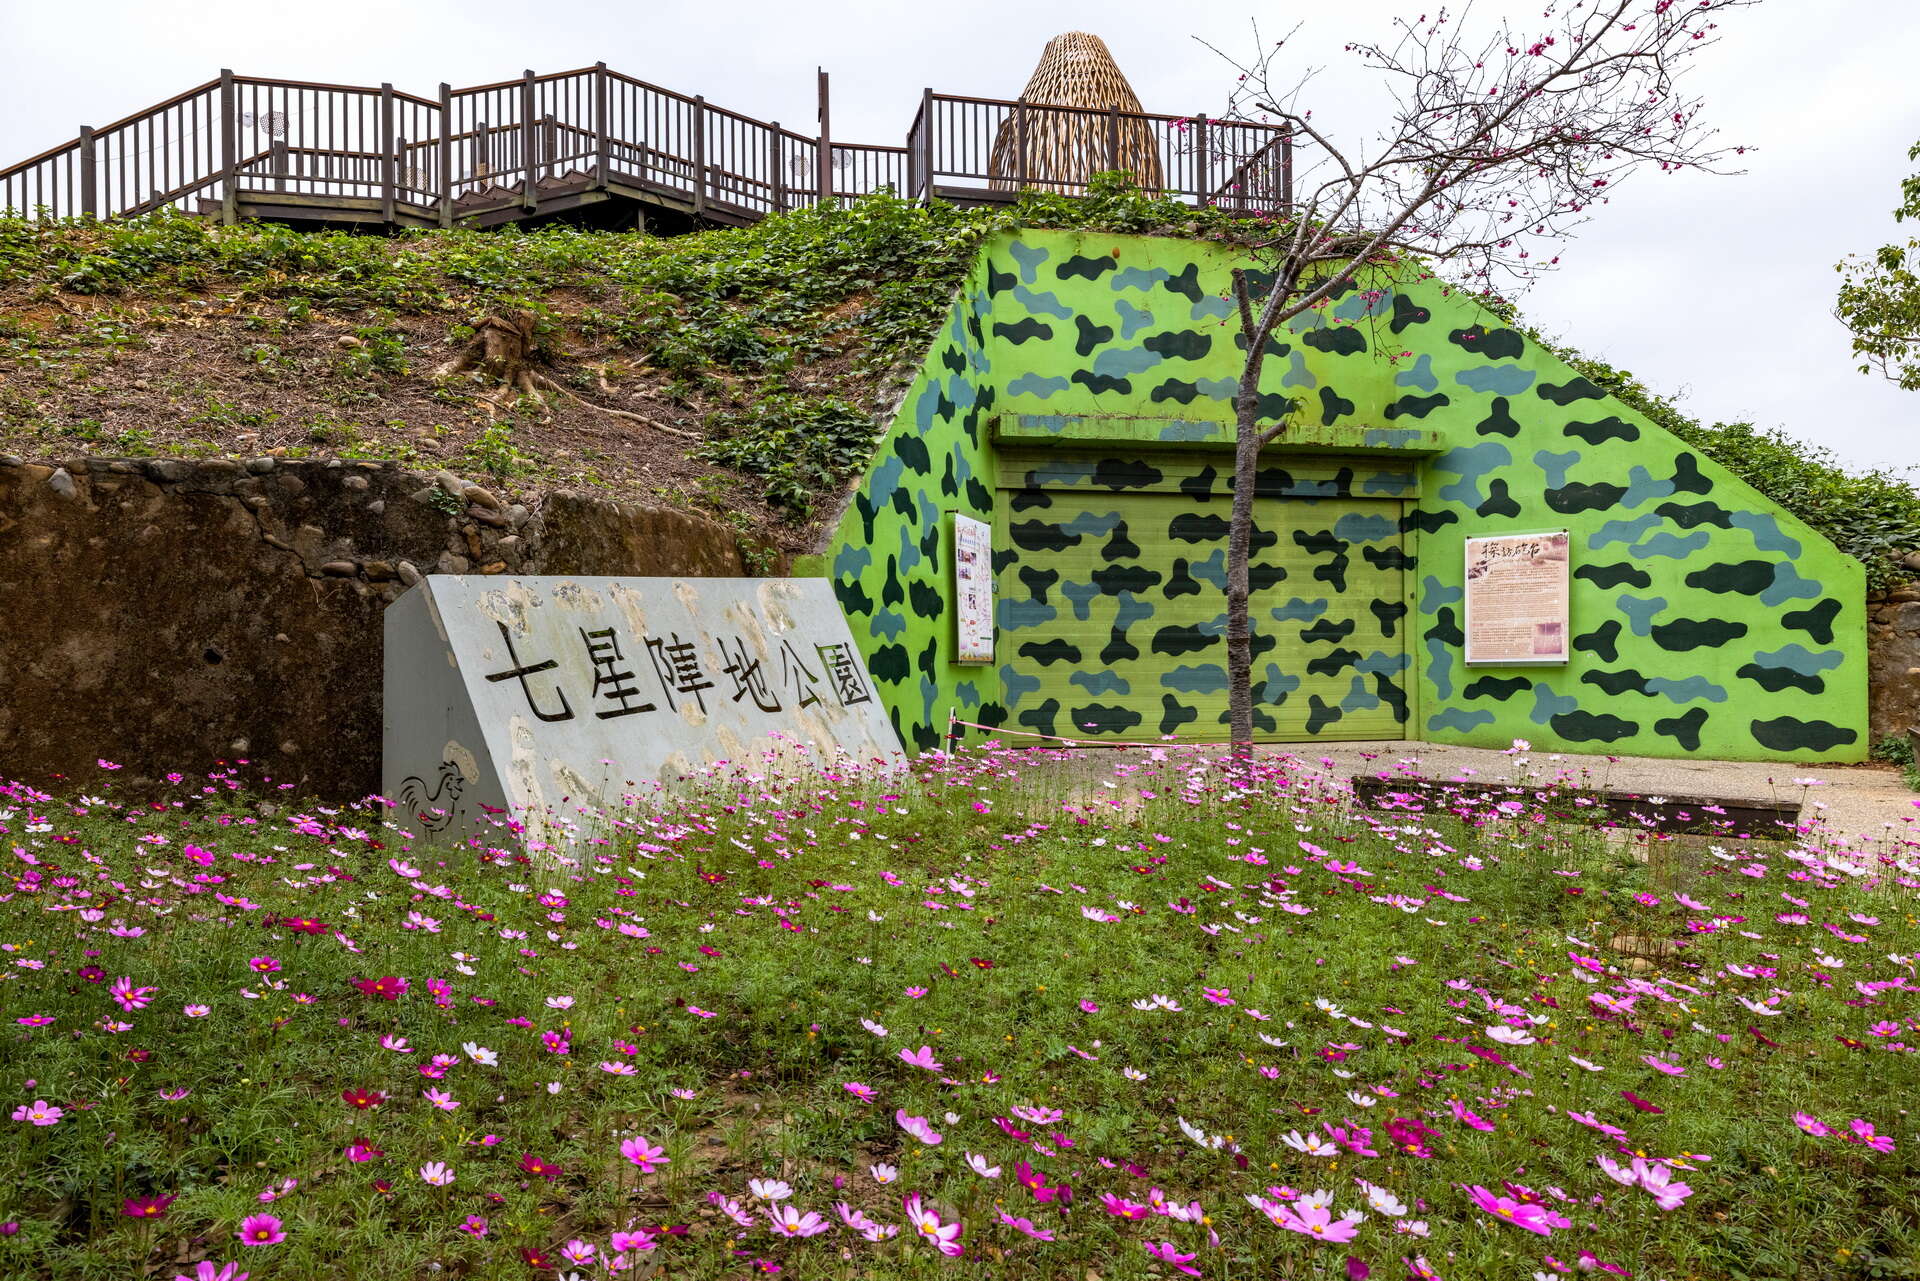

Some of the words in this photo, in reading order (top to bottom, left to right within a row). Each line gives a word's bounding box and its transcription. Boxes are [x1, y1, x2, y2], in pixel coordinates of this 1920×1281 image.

[485, 621, 872, 723] 七星陣地公園
